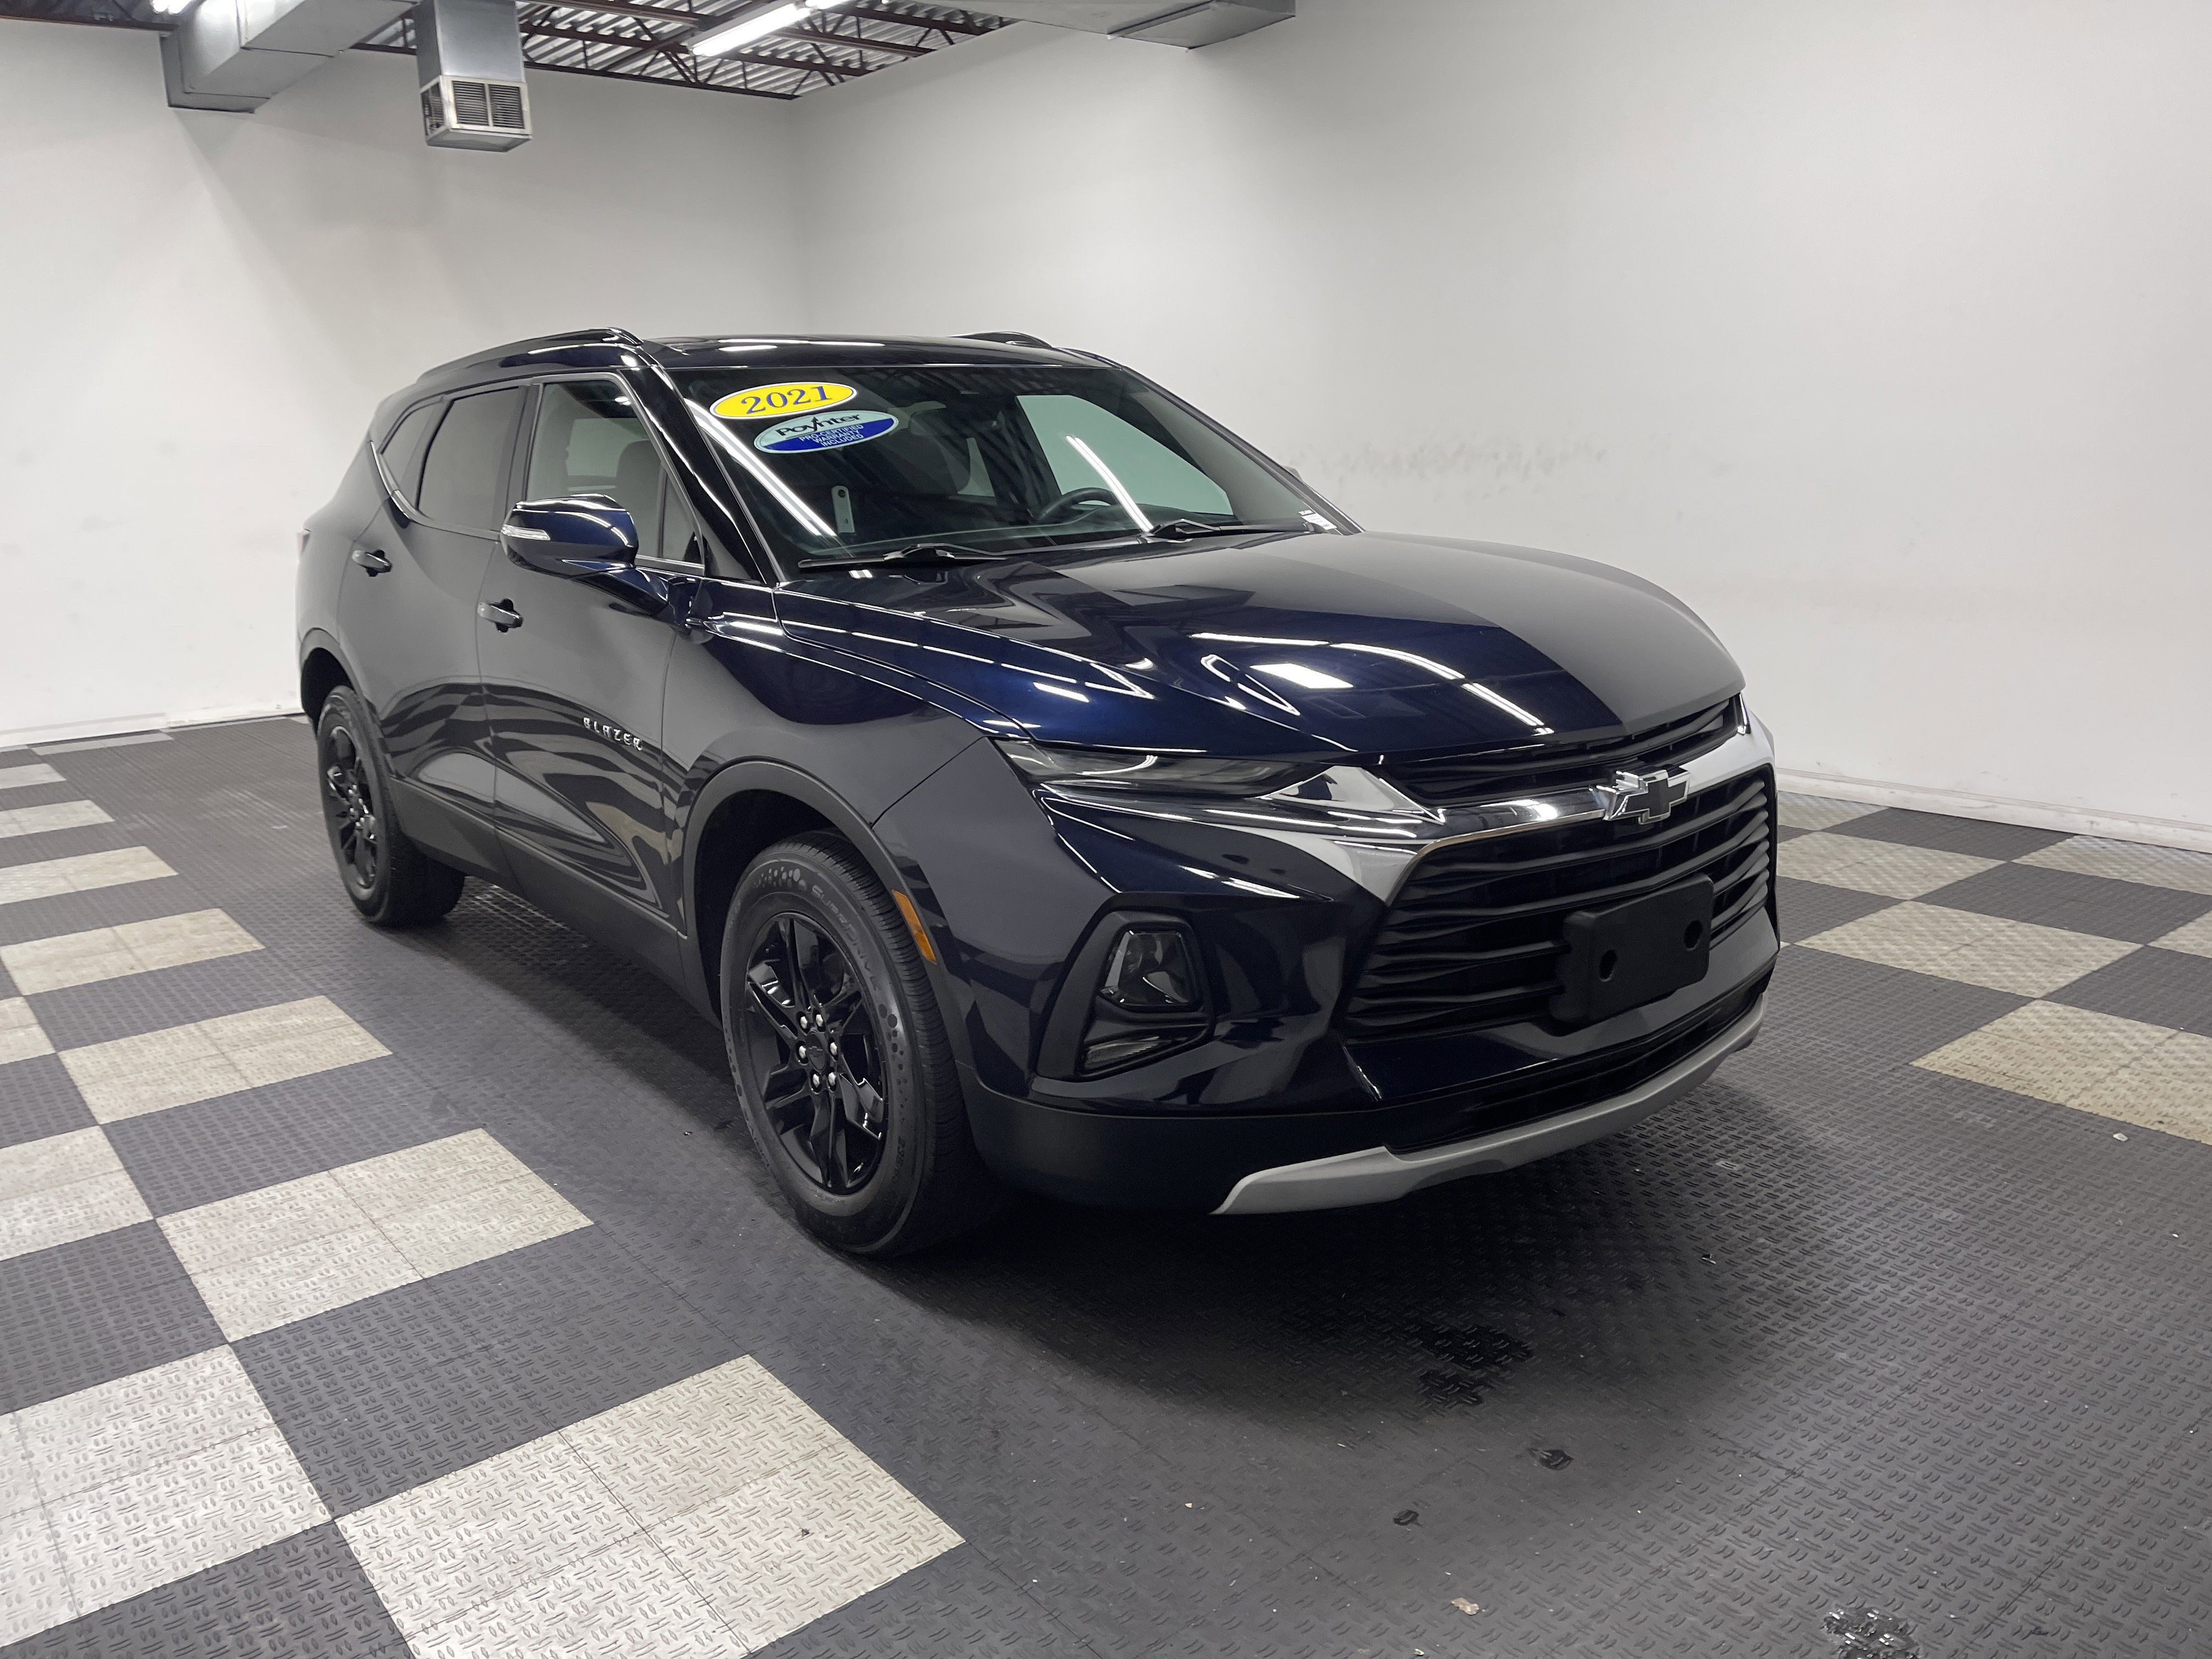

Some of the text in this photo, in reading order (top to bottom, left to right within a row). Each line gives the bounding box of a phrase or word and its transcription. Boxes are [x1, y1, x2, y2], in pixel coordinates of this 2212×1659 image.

[741, 386, 832, 414] 2021
[775, 414, 860, 436] Poynter
[799, 424, 864, 441] PRO-CERTIFIED
[812, 430, 860, 443] WARRANTY
[820, 434, 864, 447] INCLUDED
[583, 717, 642, 751] BLAZER
